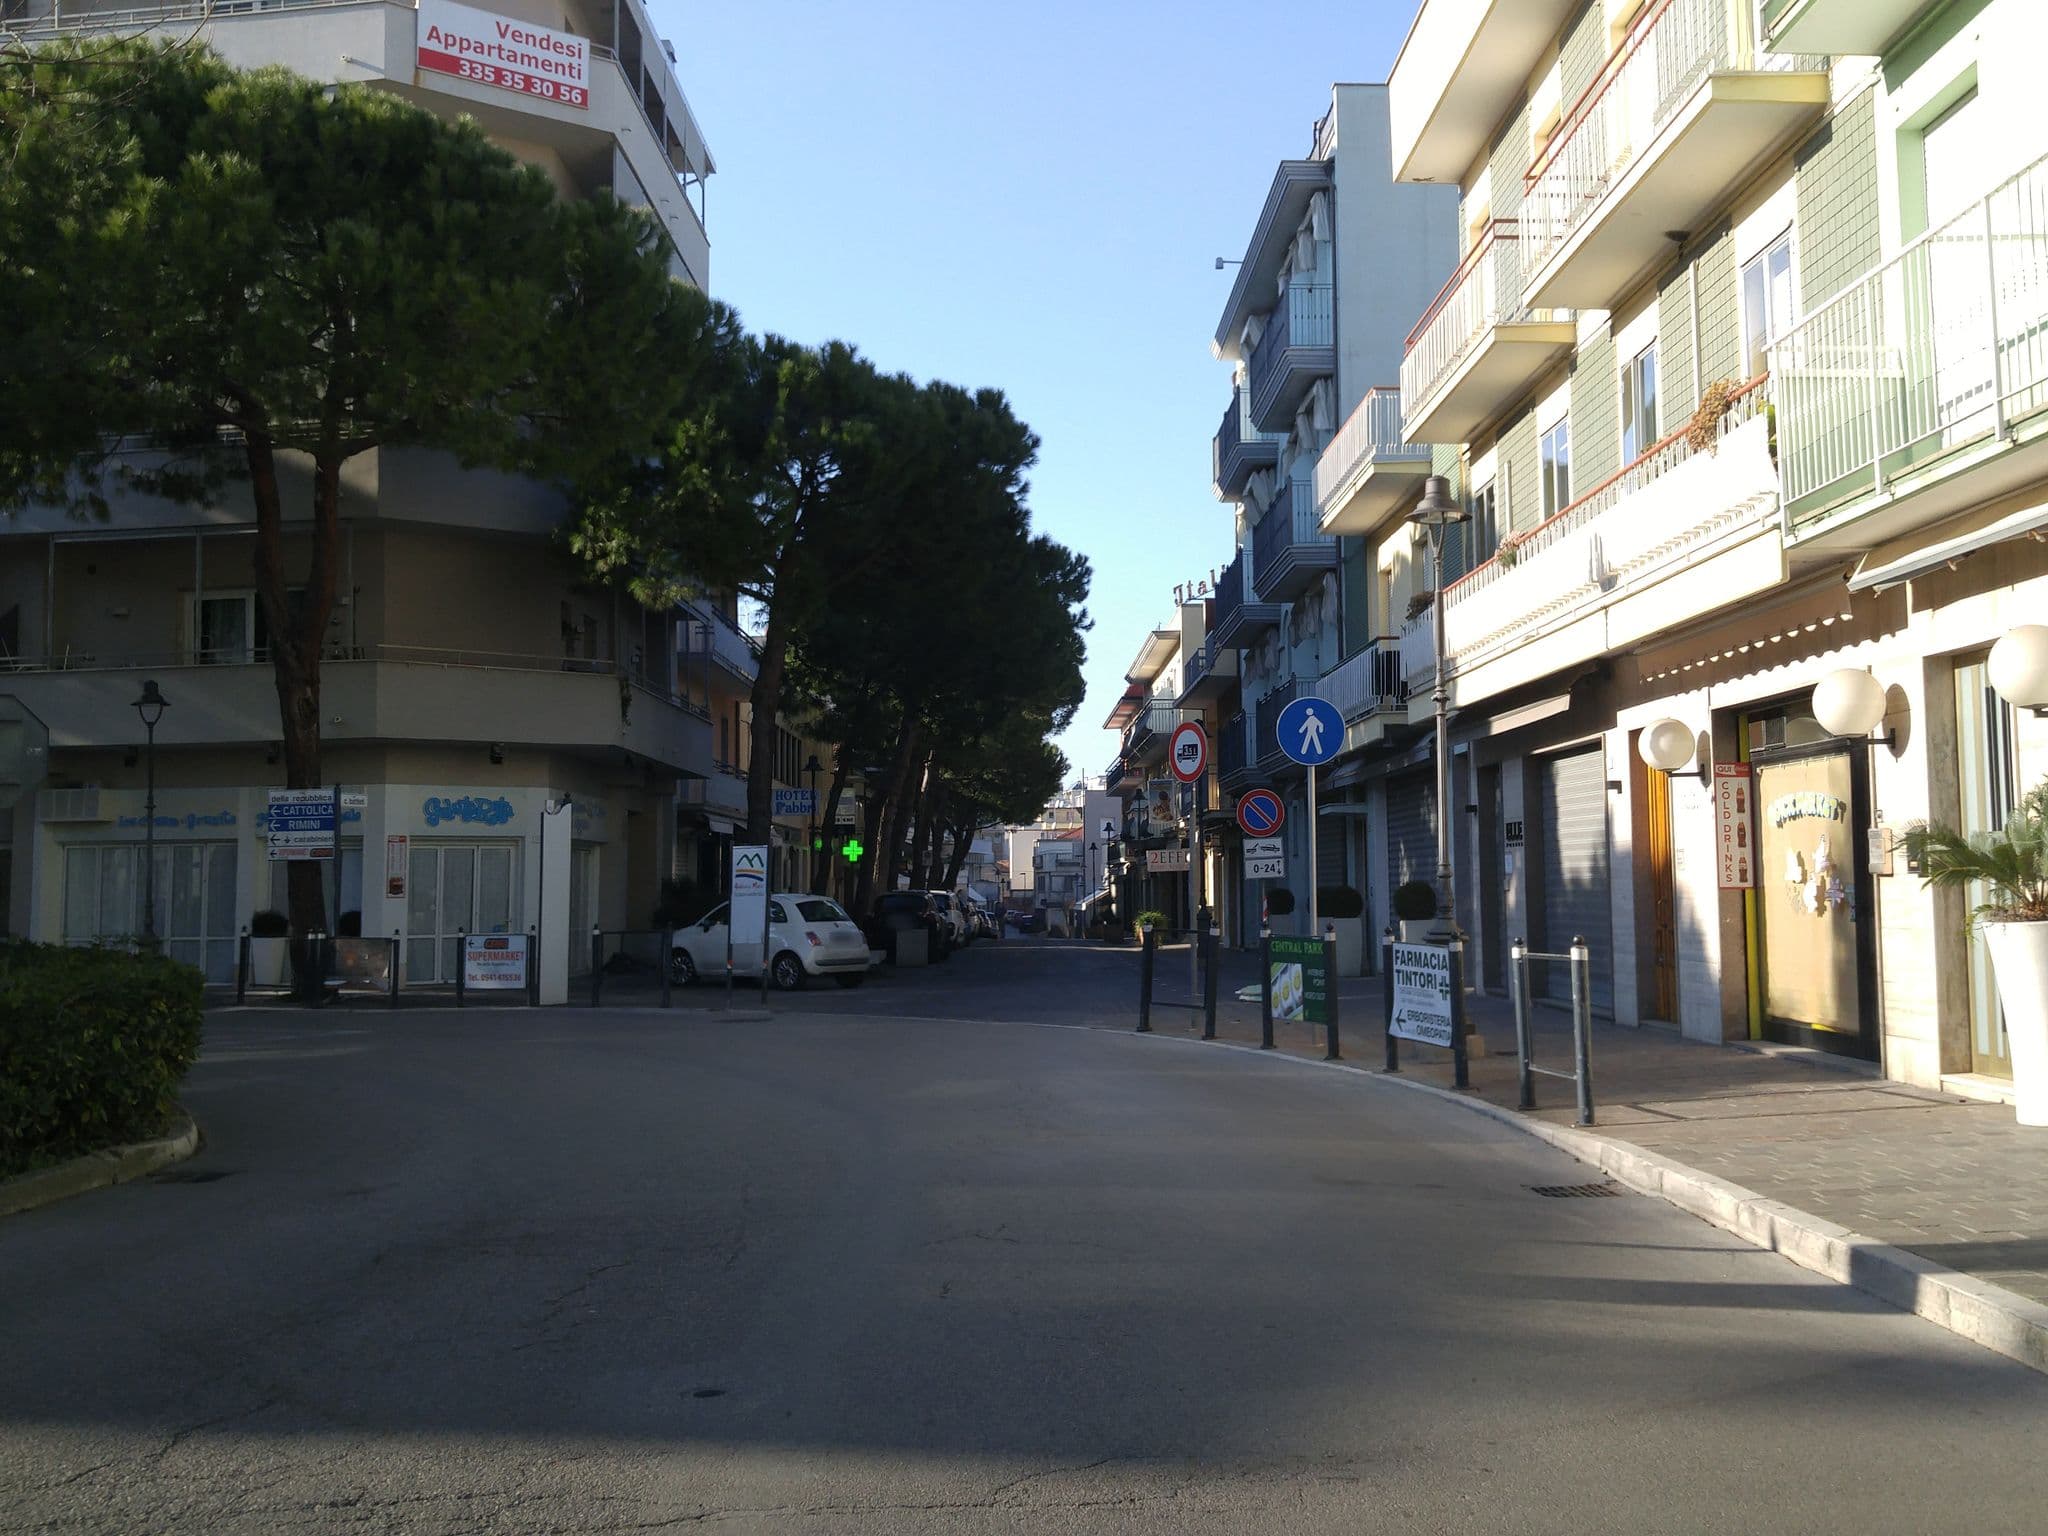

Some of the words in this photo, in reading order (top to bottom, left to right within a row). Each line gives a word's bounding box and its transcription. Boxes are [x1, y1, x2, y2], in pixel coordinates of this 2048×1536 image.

[495, 20, 583, 60] Vendesi
[426, 25, 583, 81] Appartamenti
[458, 59, 495, 83] 335
[500, 70, 525, 90] 35
[530, 78, 554, 97] 30
[559, 85, 582, 104] 56
[1717, 765, 1732, 773] QUI
[282, 804, 335, 815] CATTOLICA
[1721, 781, 1731, 820] COLD
[288, 818, 321, 830] RIMINI
[1723, 824, 1733, 883] DRINKS
[1253, 863, 1276, 873] 0-24
[467, 951, 524, 961] SUPERMARKET
[1270, 940, 1302, 953] CENTRAL
[1303, 941, 1325, 955] PARK
[1394, 949, 1449, 972] FARMACIA
[1395, 968, 1438, 990] TINTORI
[1407, 1009, 1451, 1027] ERBORISTERIA
